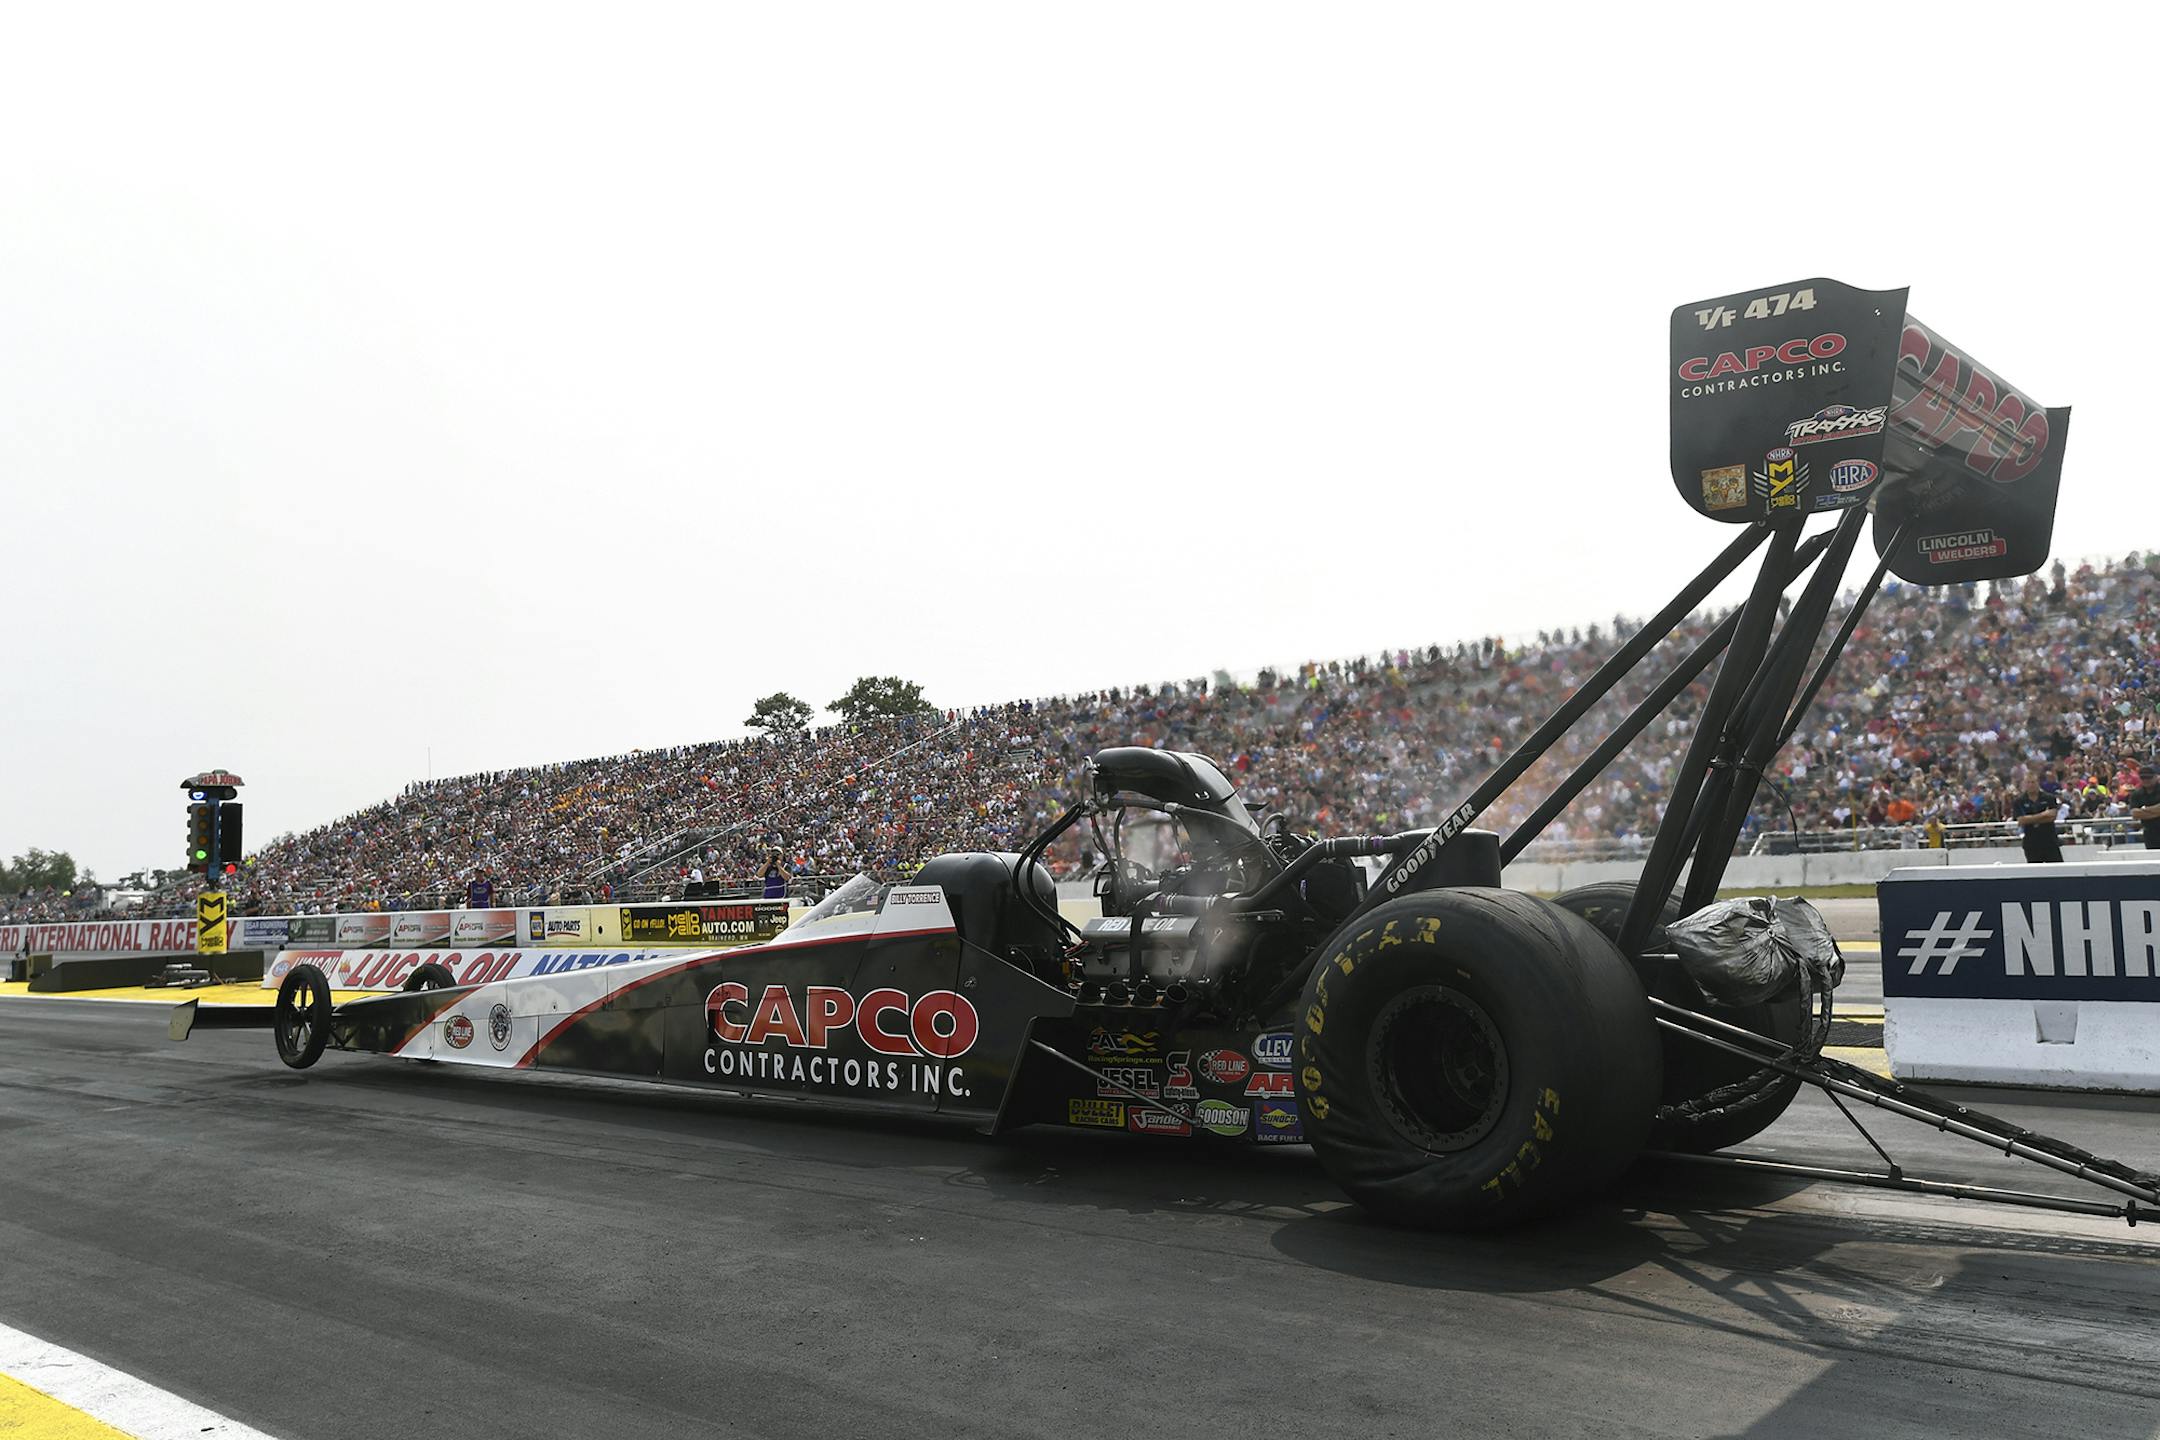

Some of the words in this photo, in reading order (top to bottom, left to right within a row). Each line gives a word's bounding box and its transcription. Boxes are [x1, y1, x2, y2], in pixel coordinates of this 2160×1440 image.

[1694, 305, 1737, 331] T/F
[1743, 287, 1818, 320] 474
[1678, 332, 1848, 382] CAPCO
[1681, 368, 1806, 399] CONTRACTORS
[1811, 361, 1846, 377] INC.
[1790, 408, 1886, 438] TRAXXAS
[1921, 532, 1990, 552] LINCOLN
[1937, 545, 1998, 561] WELDERS
[1386, 803, 1476, 894] GOODYEAR
[700, 906, 753, 921] TANNER
[770, 914, 787, 925] Jeep
[702, 921, 755, 935] AUTO.COM
[1097, 918, 1128, 931] RED
[0, 926, 19, 952] RD
[26, 921, 142, 952] INTERNATIONAL
[704, 981, 980, 1059] CAPCO
[703, 1048, 899, 1091] CONTRACTORS
[911, 1064, 971, 1098] INC.
[1212, 1060, 1226, 1072] RED
[1228, 1060, 1246, 1072] LINE
[1098, 1068, 1159, 1090] JESEL
[1197, 1108, 1250, 1126] GOODSON
[1262, 1113, 1297, 1123] SUNOCO
